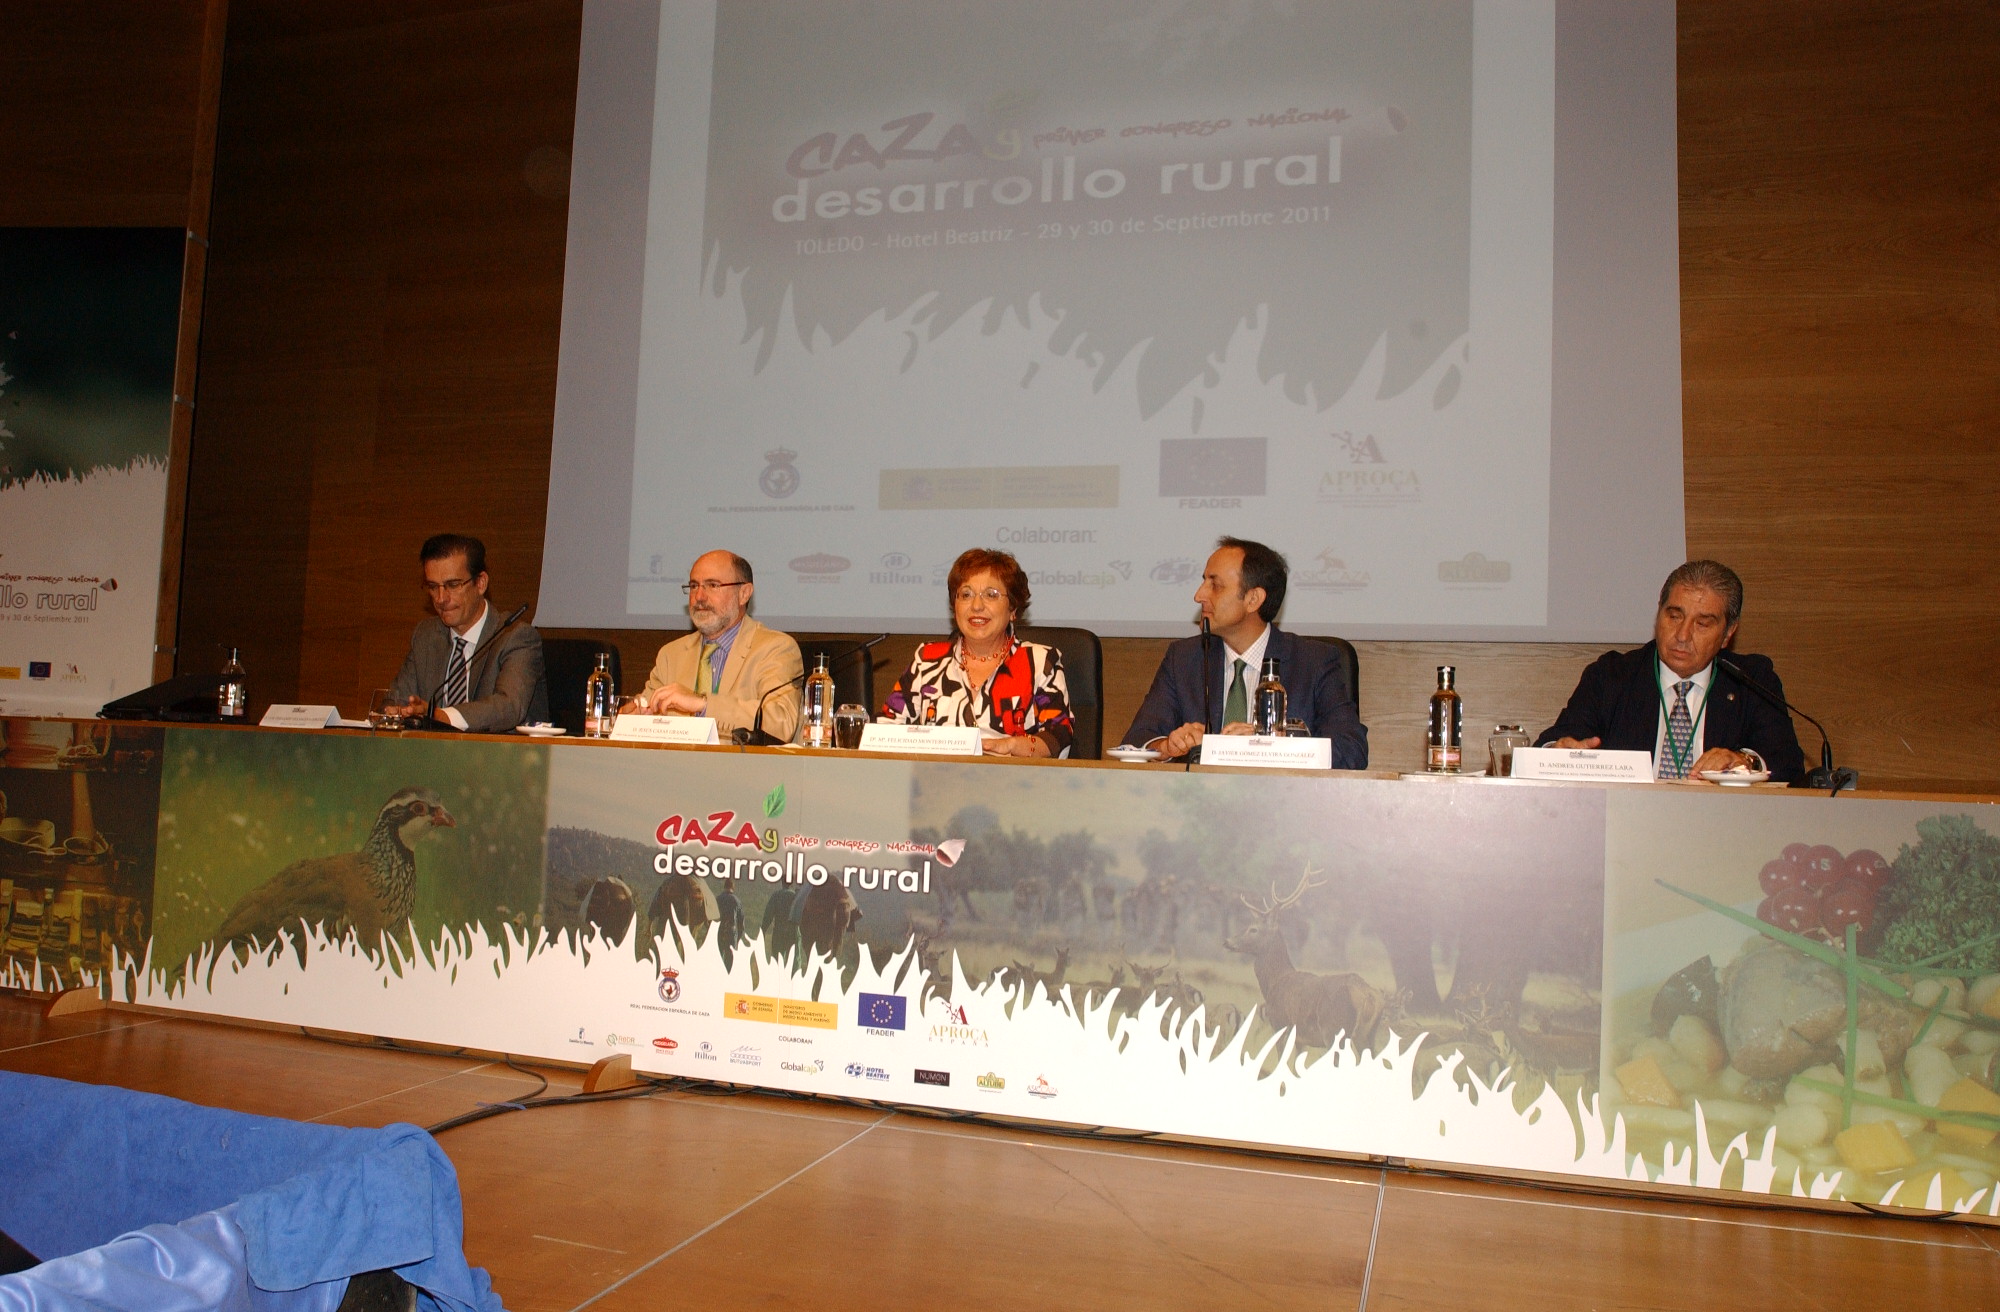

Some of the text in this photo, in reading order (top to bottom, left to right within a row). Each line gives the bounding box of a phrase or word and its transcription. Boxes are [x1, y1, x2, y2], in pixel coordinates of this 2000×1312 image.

[785, 111, 980, 179] CAZA
[772, 135, 1343, 223] desarrollo rural
[794, 235, 865, 257] TOLEDO
[887, 231, 938, 252] Hotel
[945, 227, 1014, 247] Beatriz
[1037, 222, 1061, 241] 29
[1069, 225, 1082, 244] y
[1087, 217, 1114, 237] 30
[1120, 213, 1147, 235] de
[1152, 205, 1275, 233] Septiembre
[1281, 205, 1332, 225] 2011
[1319, 468, 1421, 487] APROCA
[1179, 498, 1241, 510] FEADER
[870, 571, 923, 585] Hilton
[36, 587, 98, 611] rural
[34, 614, 72, 624] Septiembre
[655, 811, 762, 851] CAZA
[825, 839, 879, 852] CONGRESO
[653, 844, 932, 894] desarrollo rural
[778, 1035, 813, 1045] COLABORAN
[866, 1028, 895, 1038] FEADER
[929, 1024, 989, 1042] APROCA
[694, 1051, 717, 1062] Hilton
[780, 1061, 818, 1075] Globalcaja
